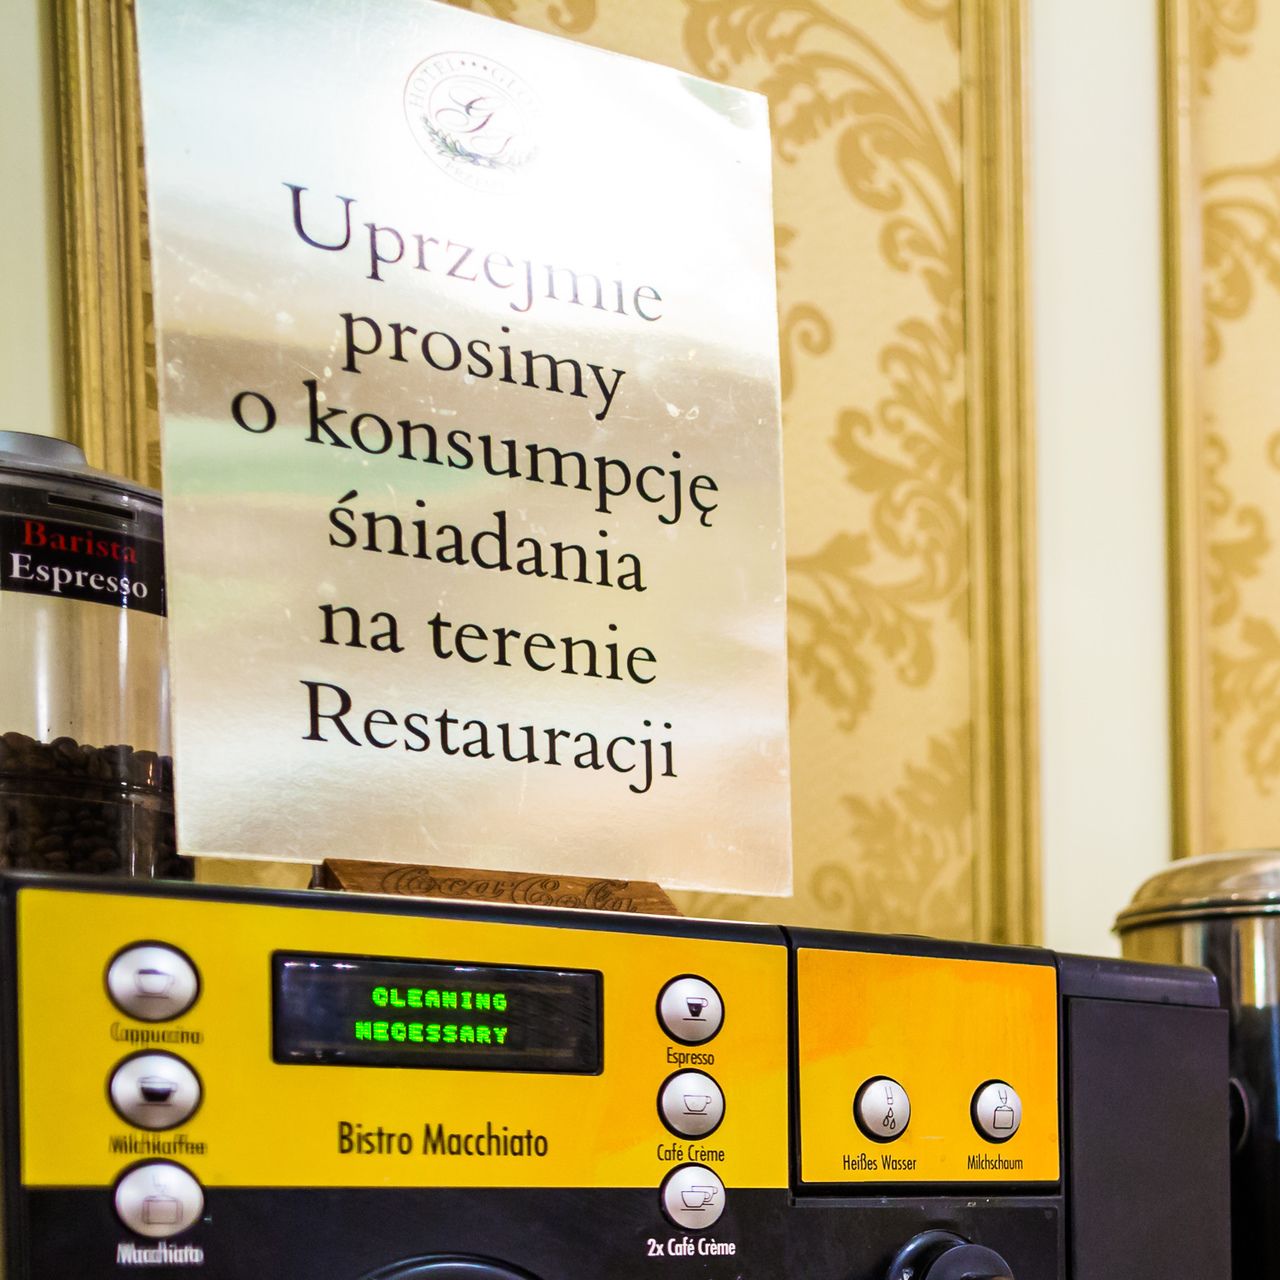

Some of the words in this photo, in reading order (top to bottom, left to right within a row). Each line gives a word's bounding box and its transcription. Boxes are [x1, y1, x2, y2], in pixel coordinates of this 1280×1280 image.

[282, 181, 665, 324] Uprzejmie
[339, 311, 627, 422] prosimy
[230, 391, 277, 434] o
[304, 379, 720, 528] konsumpcję
[23, 518, 138, 564] Barista
[328, 490, 648, 593] śniadania
[9, 552, 148, 598] Espresso
[319, 601, 406, 654] na
[429, 610, 658, 685] terenie
[299, 680, 678, 794] Restauracji
[371, 986, 508, 1012] CLEANING
[355, 1021, 508, 1045] NECESSARY
[666, 1047, 715, 1067] Espresso
[337, 1121, 413, 1155] Bistro
[422, 1121, 548, 1157] Macchiato
[657, 1143, 683, 1163] Café
[687, 1143, 726, 1164] Crème
[842, 1154, 878, 1171] Heißes
[881, 1154, 918, 1172] Wasser
[967, 1154, 1024, 1171] Milchschaum
[647, 1239, 664, 1257] 2x
[667, 1237, 695, 1257] Café
[697, 1237, 736, 1258] Crème
